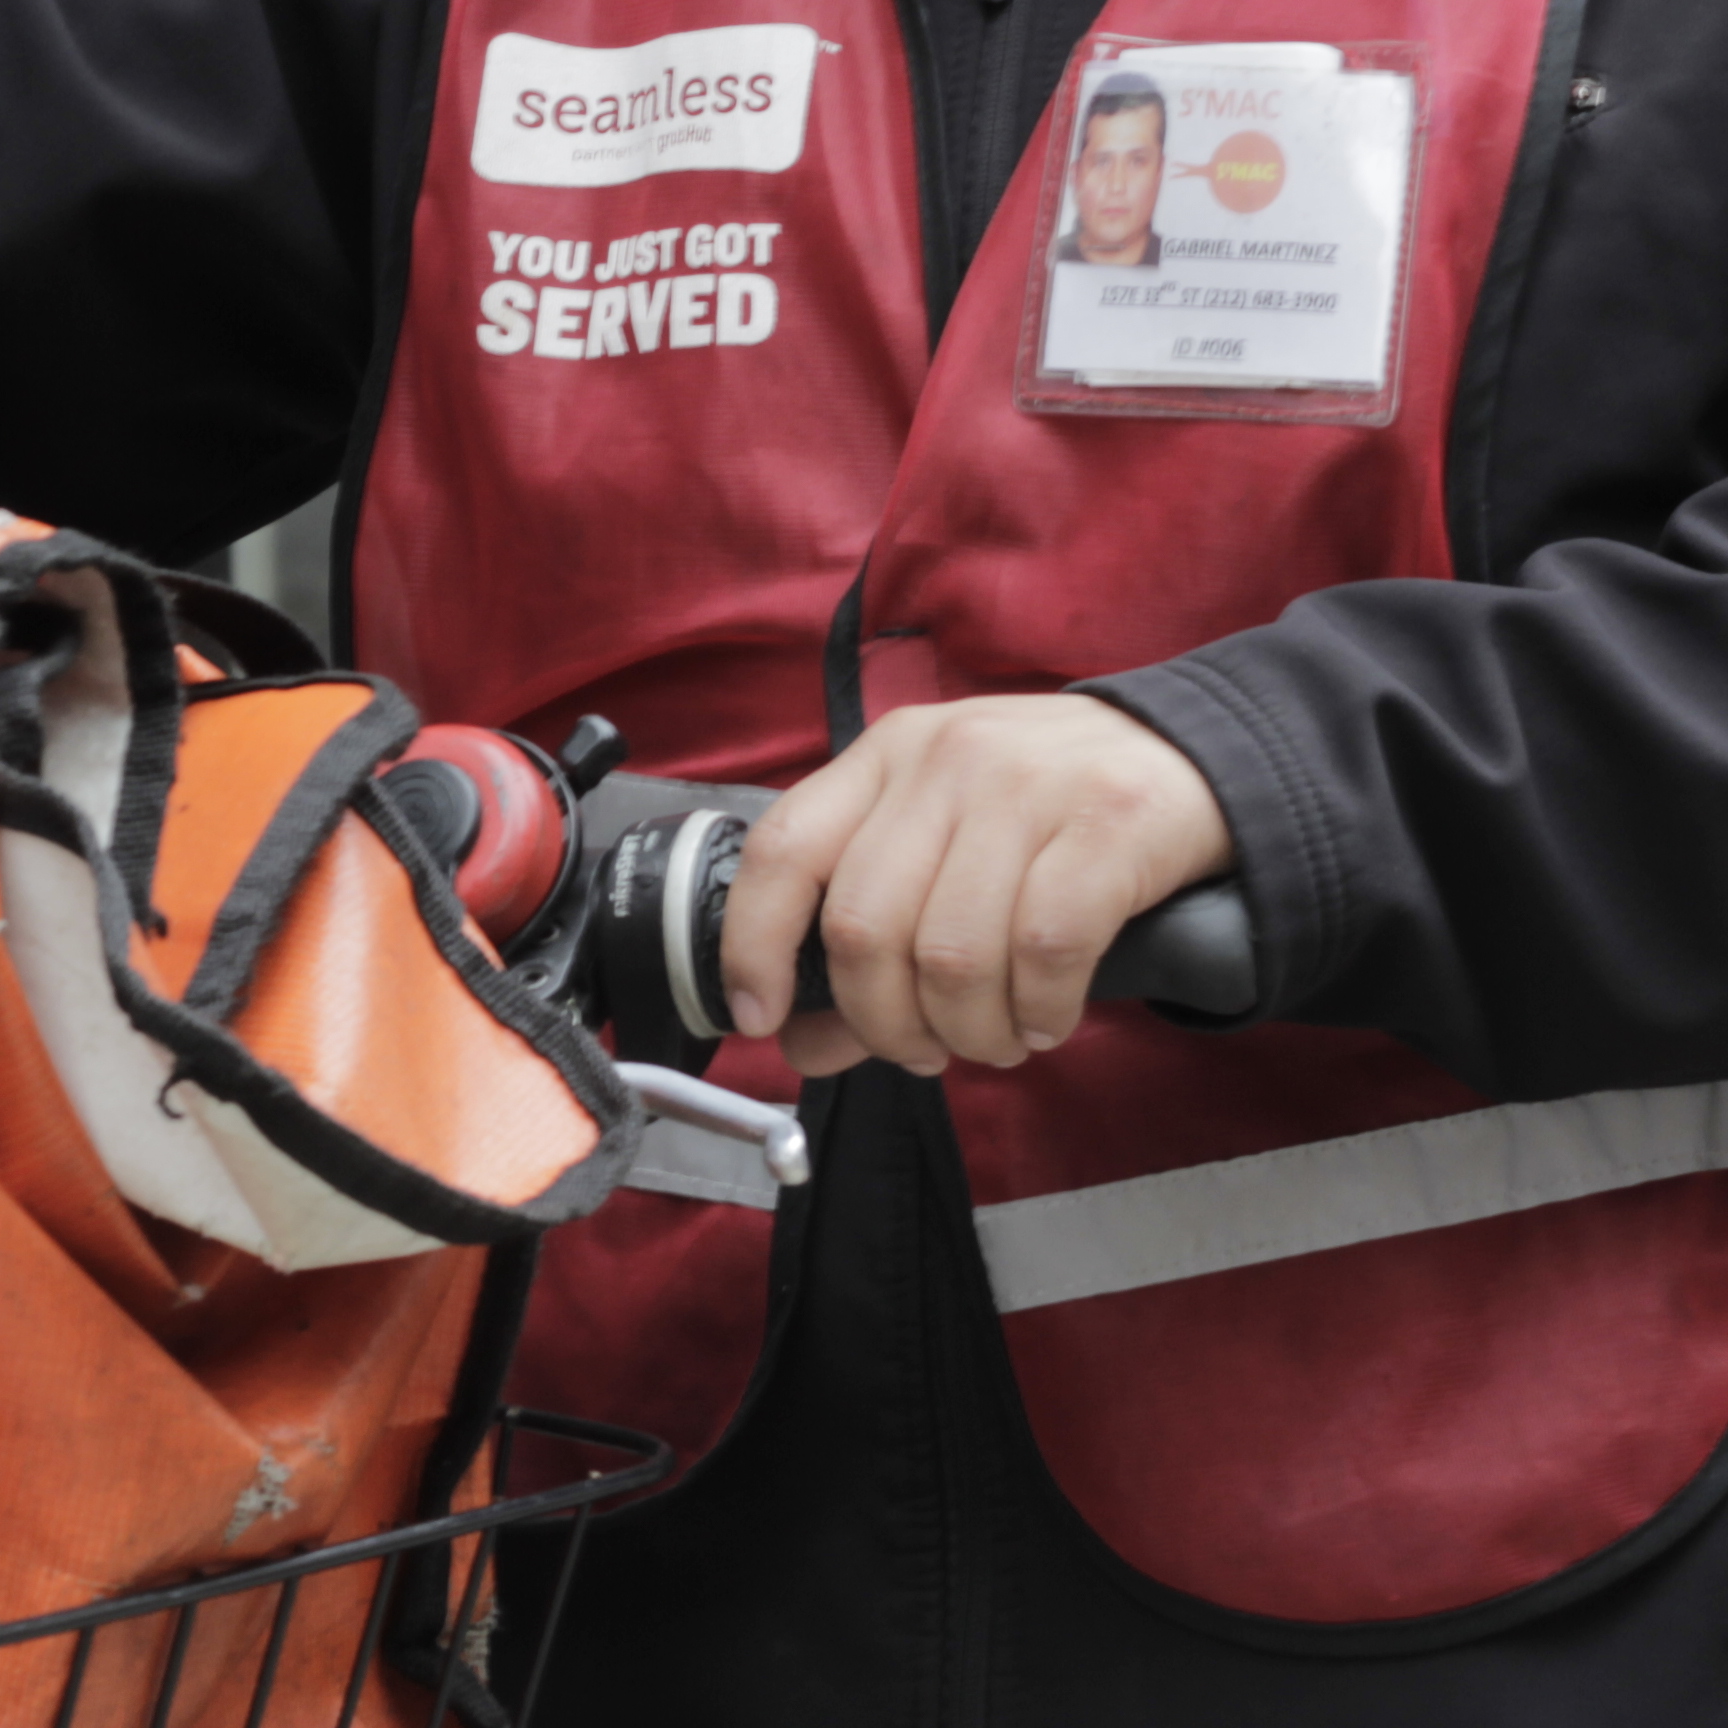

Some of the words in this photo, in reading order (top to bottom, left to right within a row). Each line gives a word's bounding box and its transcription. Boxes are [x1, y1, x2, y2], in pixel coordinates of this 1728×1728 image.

[513, 67, 774, 135] seamless
[1178, 87, 1282, 119] S'MAC
[488, 230, 592, 282] YOU
[593, 227, 682, 283] JUST
[684, 222, 783, 269] GOT
[1163, 238, 1234, 258] GABRIEL
[1238, 240, 1339, 262] MARTINEZ
[1203, 287, 1247, 309] (212)
[475, 272, 780, 360] SERVED
[1171, 335, 1195, 357] ID
[1195, 336, 1248, 359] #006
